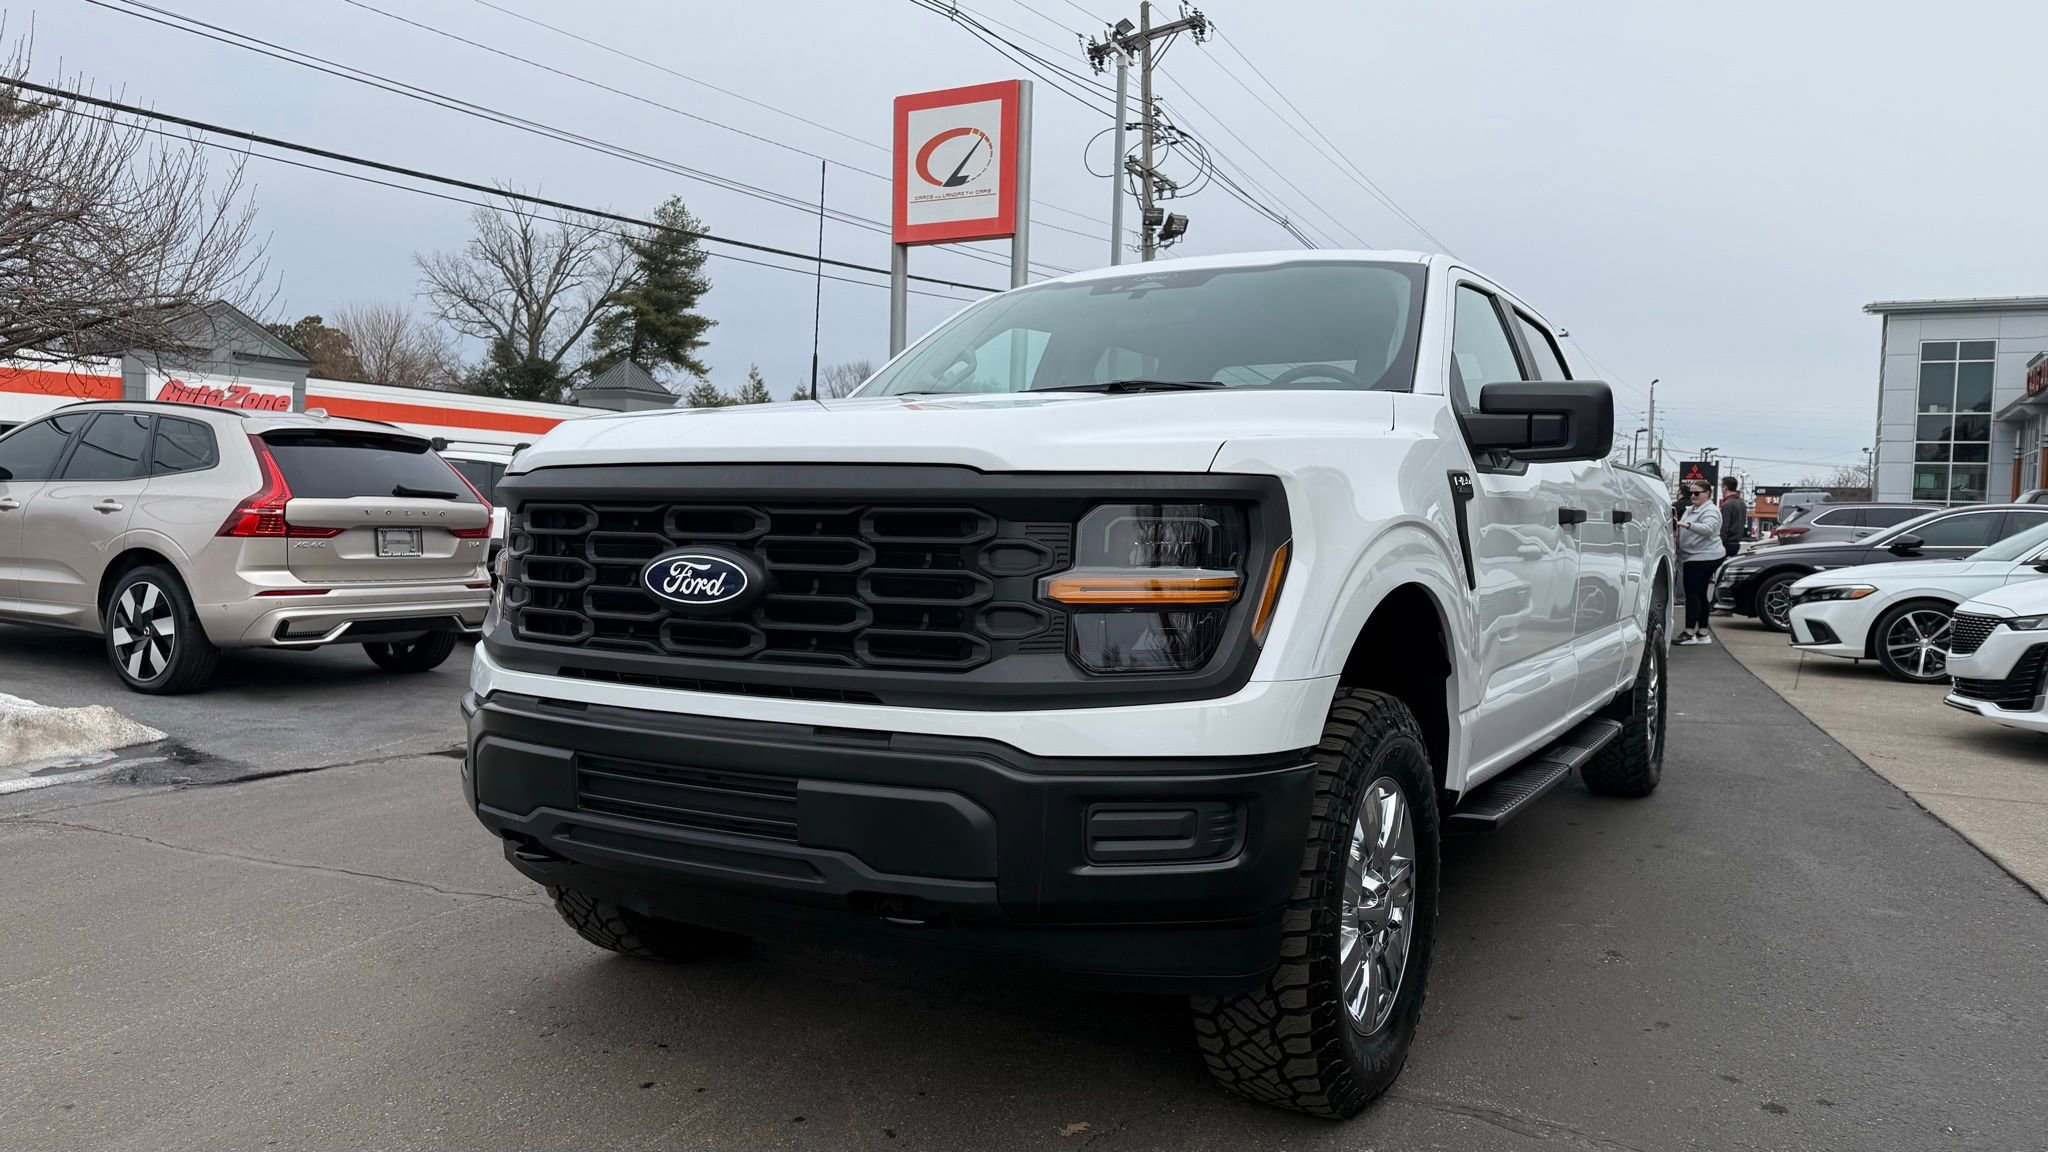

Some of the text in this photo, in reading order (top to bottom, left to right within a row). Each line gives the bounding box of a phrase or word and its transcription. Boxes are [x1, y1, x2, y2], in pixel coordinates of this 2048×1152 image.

[156, 379, 291, 411] AutoZone
[364, 509, 446, 517] VOLVO
[663, 561, 727, 596] Ford
